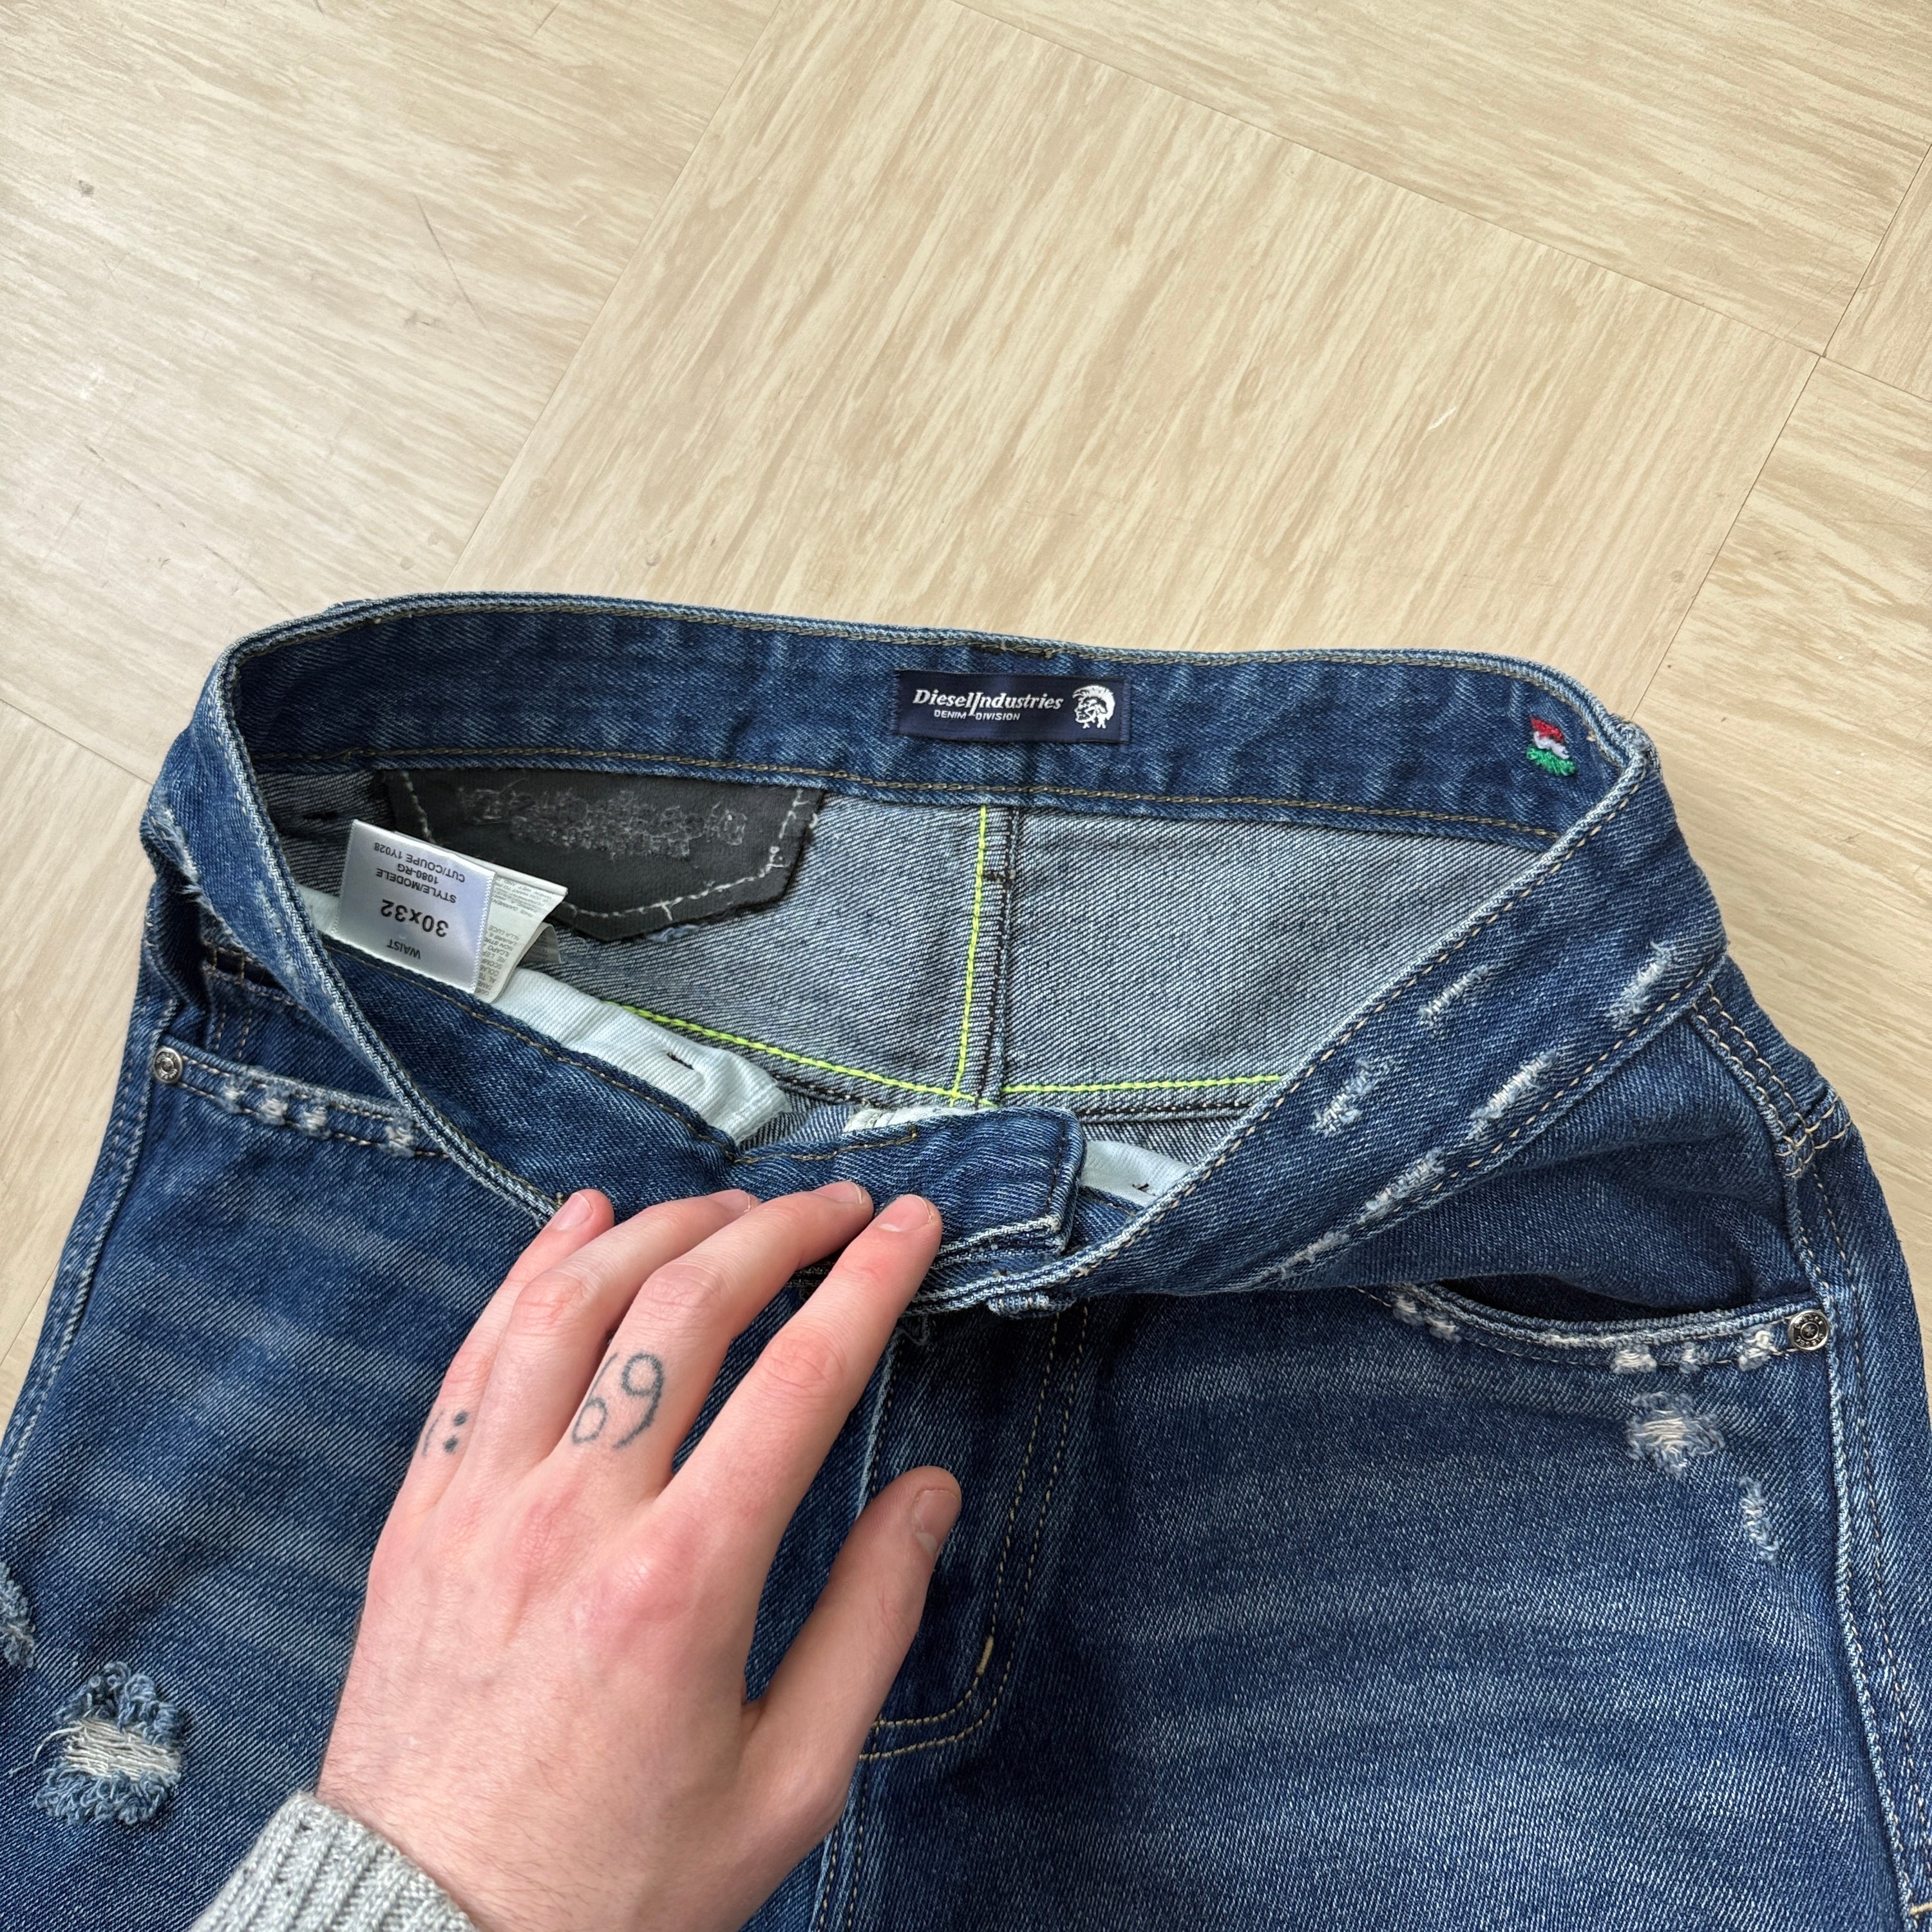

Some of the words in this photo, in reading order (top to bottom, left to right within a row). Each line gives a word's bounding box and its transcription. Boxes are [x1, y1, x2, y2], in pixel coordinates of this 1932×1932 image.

[934, 709, 966, 719] DENIM
[975, 712, 1020, 721] DIVISION
[374, 842, 402, 859] 1Y028
[397, 863, 439, 884] 1080-RG
[406, 853, 466, 883] CUT/COUPE
[375, 868, 457, 904] STYLE/MODELE
[381, 899, 449, 938] 30x32
[488, 925, 505, 935] LUCE
[387, 938, 421, 959] WAIST
[572, 1352, 664, 1451] 69
